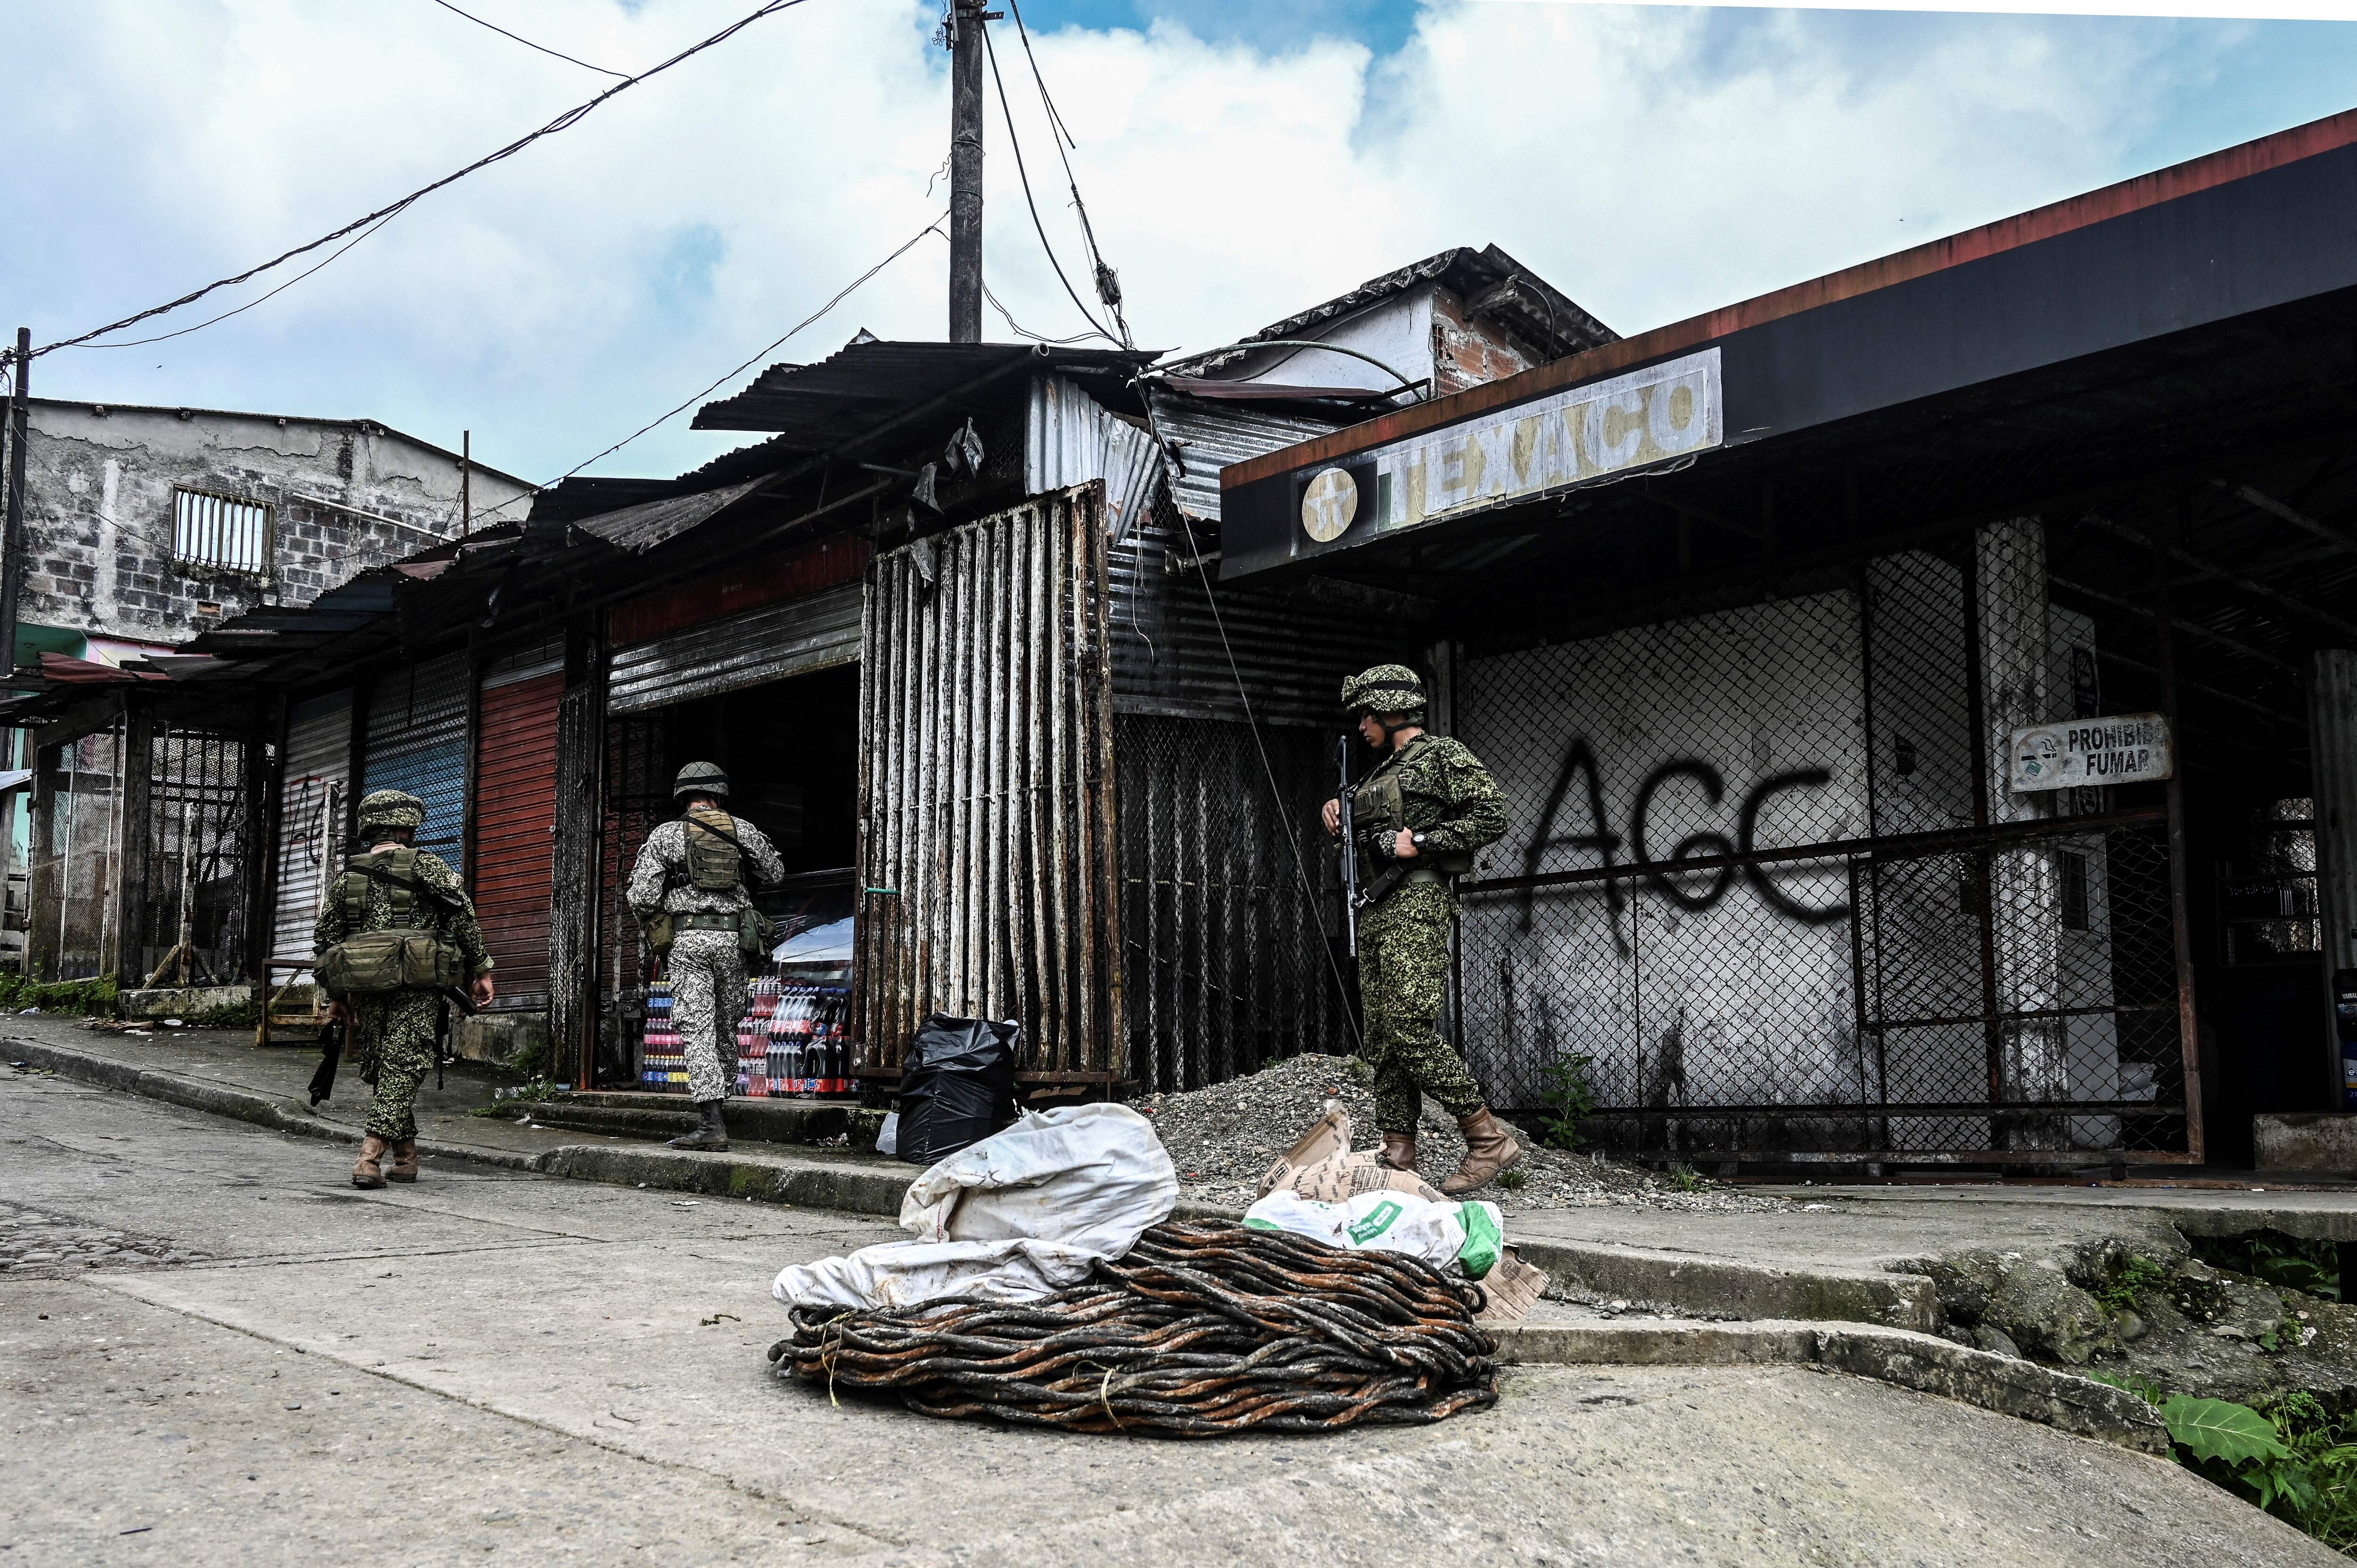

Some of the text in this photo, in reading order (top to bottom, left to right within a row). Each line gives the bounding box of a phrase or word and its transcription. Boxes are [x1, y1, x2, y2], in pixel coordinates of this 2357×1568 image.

[1377, 374, 1705, 524] TEXACO
[2086, 749, 2150, 776] FUMAR
[1517, 738, 1850, 957] AGC
[1351, 1166, 1361, 1187] ARRIBA
